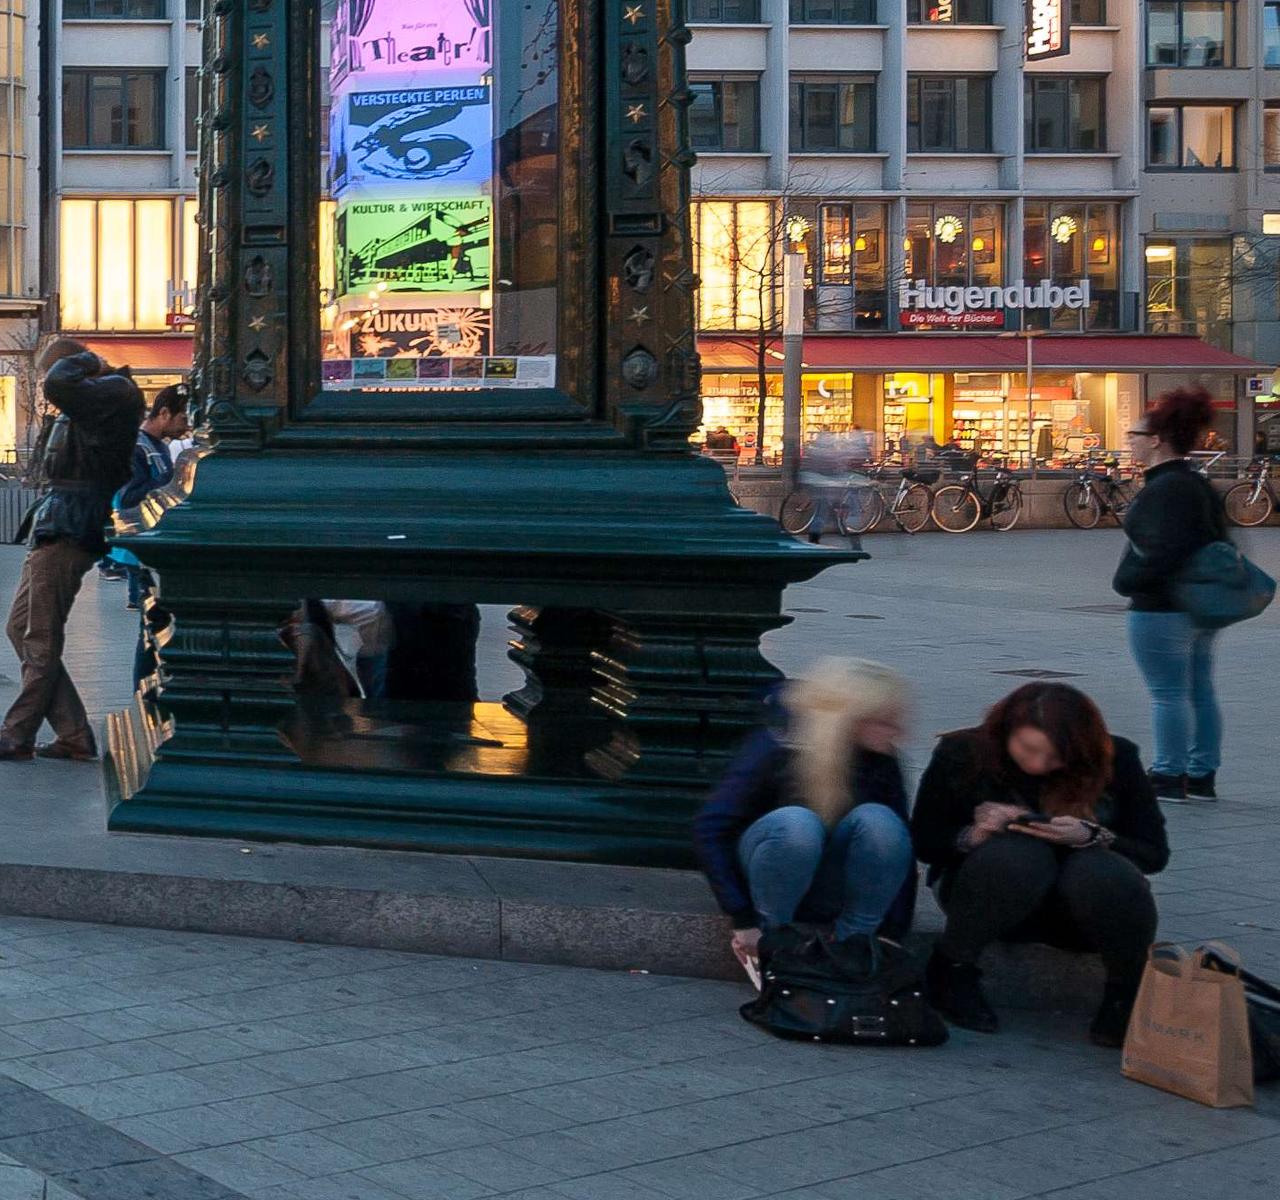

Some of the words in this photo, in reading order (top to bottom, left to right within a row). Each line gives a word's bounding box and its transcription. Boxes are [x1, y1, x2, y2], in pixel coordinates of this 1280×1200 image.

[362, 27, 477, 66] Theater!
[352, 90, 432, 107] VERSTECKTE
[434, 87, 485, 102] PERLEN
[352, 203, 396, 215] KULTUR
[399, 203, 407, 212] &
[411, 200, 484, 212] WIRTSCHAFT
[898, 278, 1090, 315] Hugendubel
[361, 311, 442, 333] ZUKUN
[909, 313, 924, 323] Die
[926, 313, 946, 323] Welt
[947, 313, 963, 323] der
[964, 313, 996, 323] Bücher
